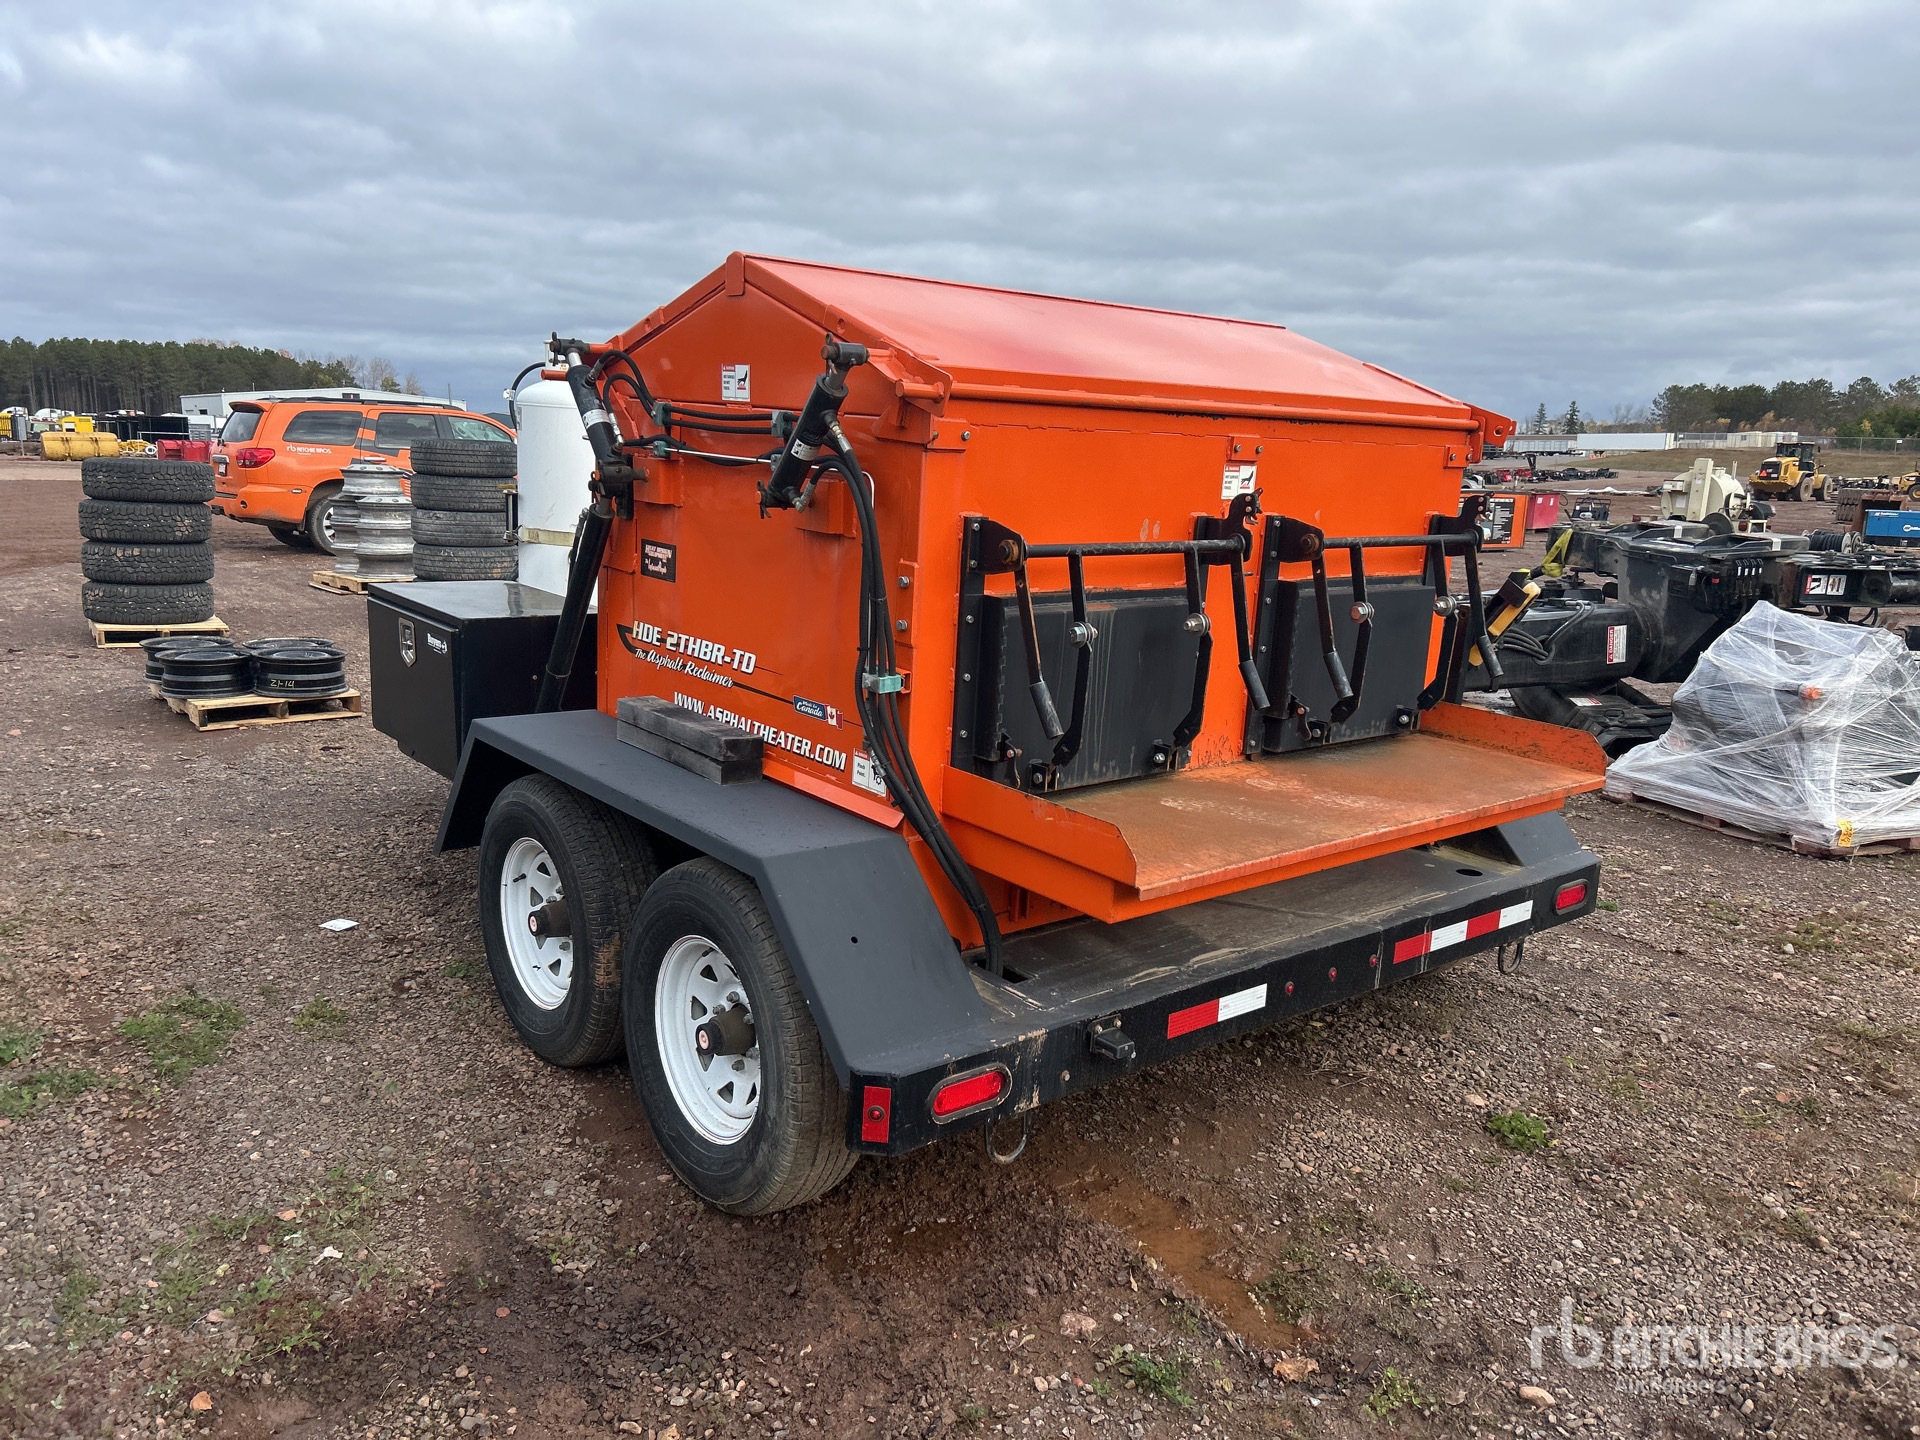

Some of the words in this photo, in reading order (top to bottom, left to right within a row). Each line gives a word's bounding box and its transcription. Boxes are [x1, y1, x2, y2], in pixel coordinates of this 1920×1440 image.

[632, 620, 662, 646] HDE
[666, 630, 757, 674] 2THBR-TD
[635, 648, 646, 660] The
[647, 649, 683, 671] Asphalt
[684, 661, 734, 688] Reclaimer
[796, 701, 824, 717] Canada
